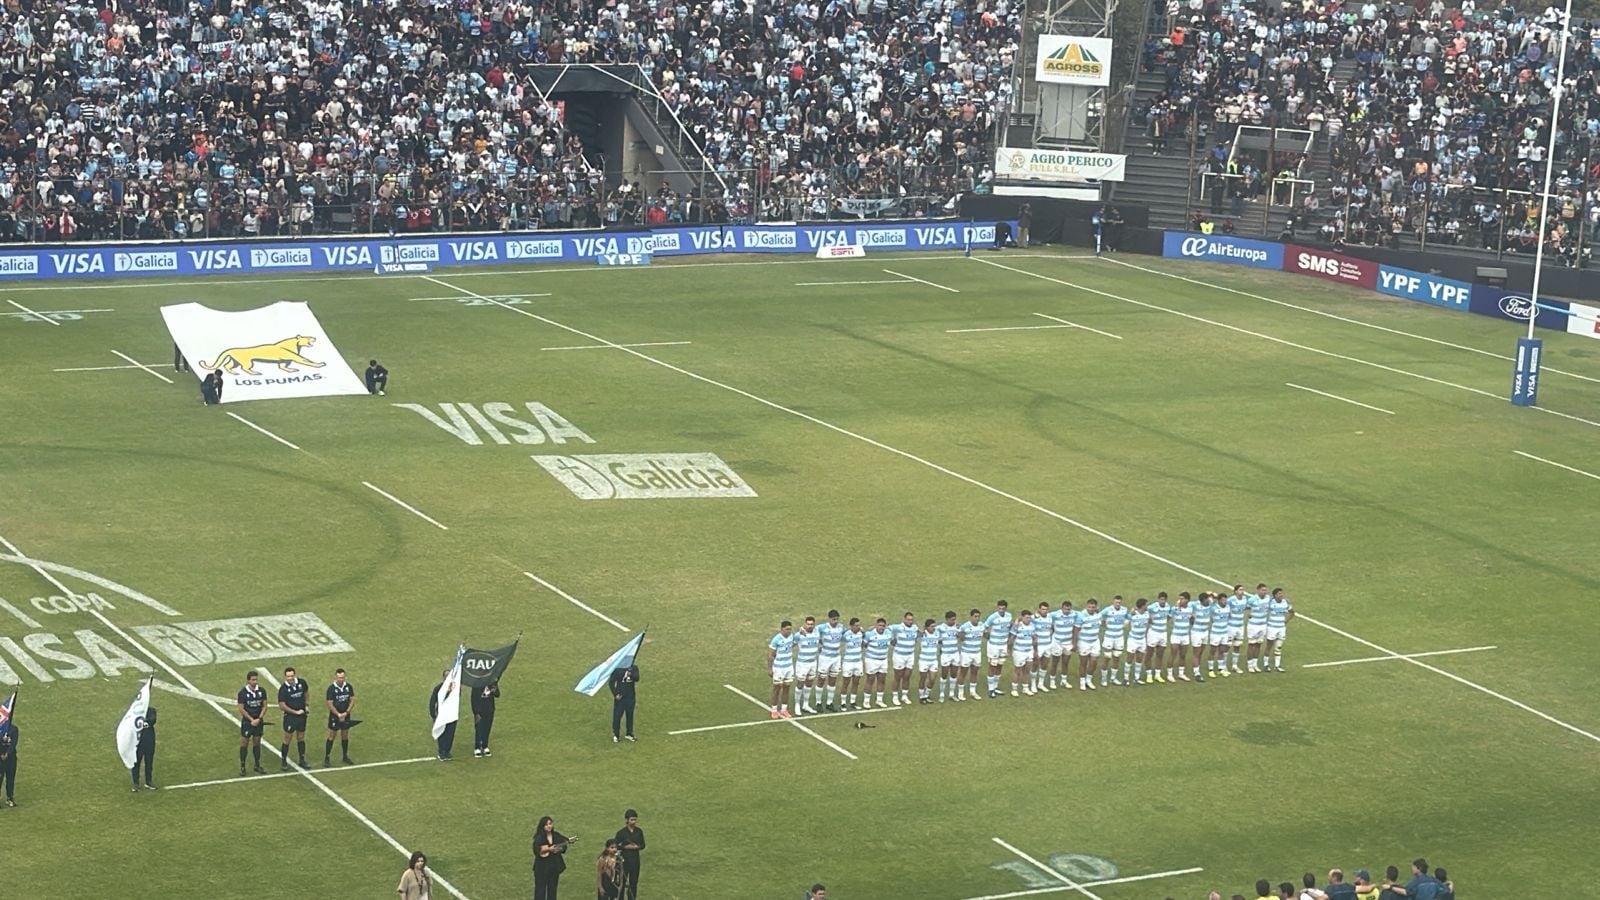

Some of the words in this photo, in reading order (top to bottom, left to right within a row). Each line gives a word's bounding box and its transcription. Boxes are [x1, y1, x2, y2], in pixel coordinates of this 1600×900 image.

[1047, 62, 1099, 73] AGROSS
[1030, 153, 1065, 165] AGRO
[1067, 155, 1113, 167] PERICO
[645, 235, 677, 251] Galicia
[688, 230, 734, 249] VISA
[761, 232, 794, 245] Galicia
[804, 229, 848, 248] VISA
[872, 231, 904, 243] Galicia
[913, 227, 956, 245] VISA
[321, 246, 372, 265] VISA
[399, 245, 436, 259] Galicia
[448, 241, 498, 261] VISA
[524, 242, 559, 255] Galicia
[571, 237, 619, 256] VISA
[1208, 242, 1267, 262] AirEuropa
[49, 254, 104, 273] VISA
[135, 254, 174, 269] Galicia
[187, 250, 242, 270] VISA
[270, 250, 308, 264] Galicia
[604, 254, 642, 265] YPF
[1298, 252, 1339, 275] SMS
[382, 263, 404, 271] VISA
[1379, 270, 1421, 294] YPF
[1428, 281, 1469, 304] YPF
[235, 378, 262, 386] LOS
[265, 373, 323, 385] PUMAS
[1514, 373, 1523, 396] VISA
[1527, 374, 1537, 398] VISA
[392, 401, 597, 445] VISA
[607, 459, 742, 490] Galicia
[30, 592, 116, 615] COPA
[207, 620, 336, 651] Galicia
[990, 853, 1119, 888] 10
